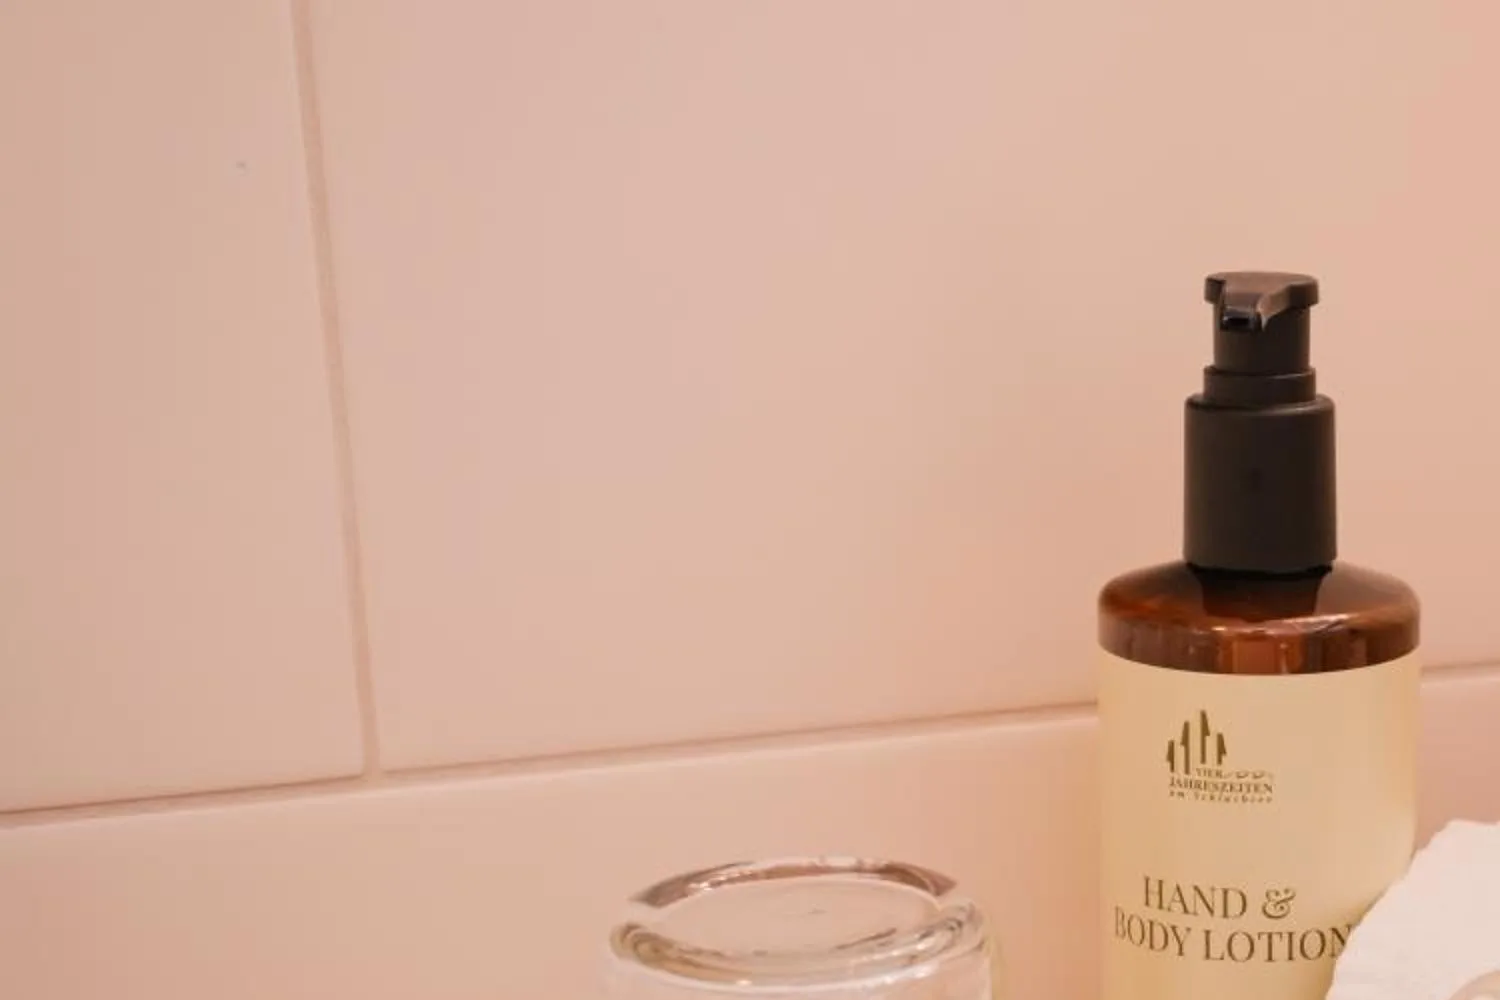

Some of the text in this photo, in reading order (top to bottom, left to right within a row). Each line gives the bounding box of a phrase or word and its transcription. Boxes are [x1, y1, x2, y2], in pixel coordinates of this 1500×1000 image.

[1169, 776, 1273, 793] JAHRESZEITEN
[1143, 875, 1297, 920] HAND &
[1113, 904, 1356, 963] BODY LOTION
